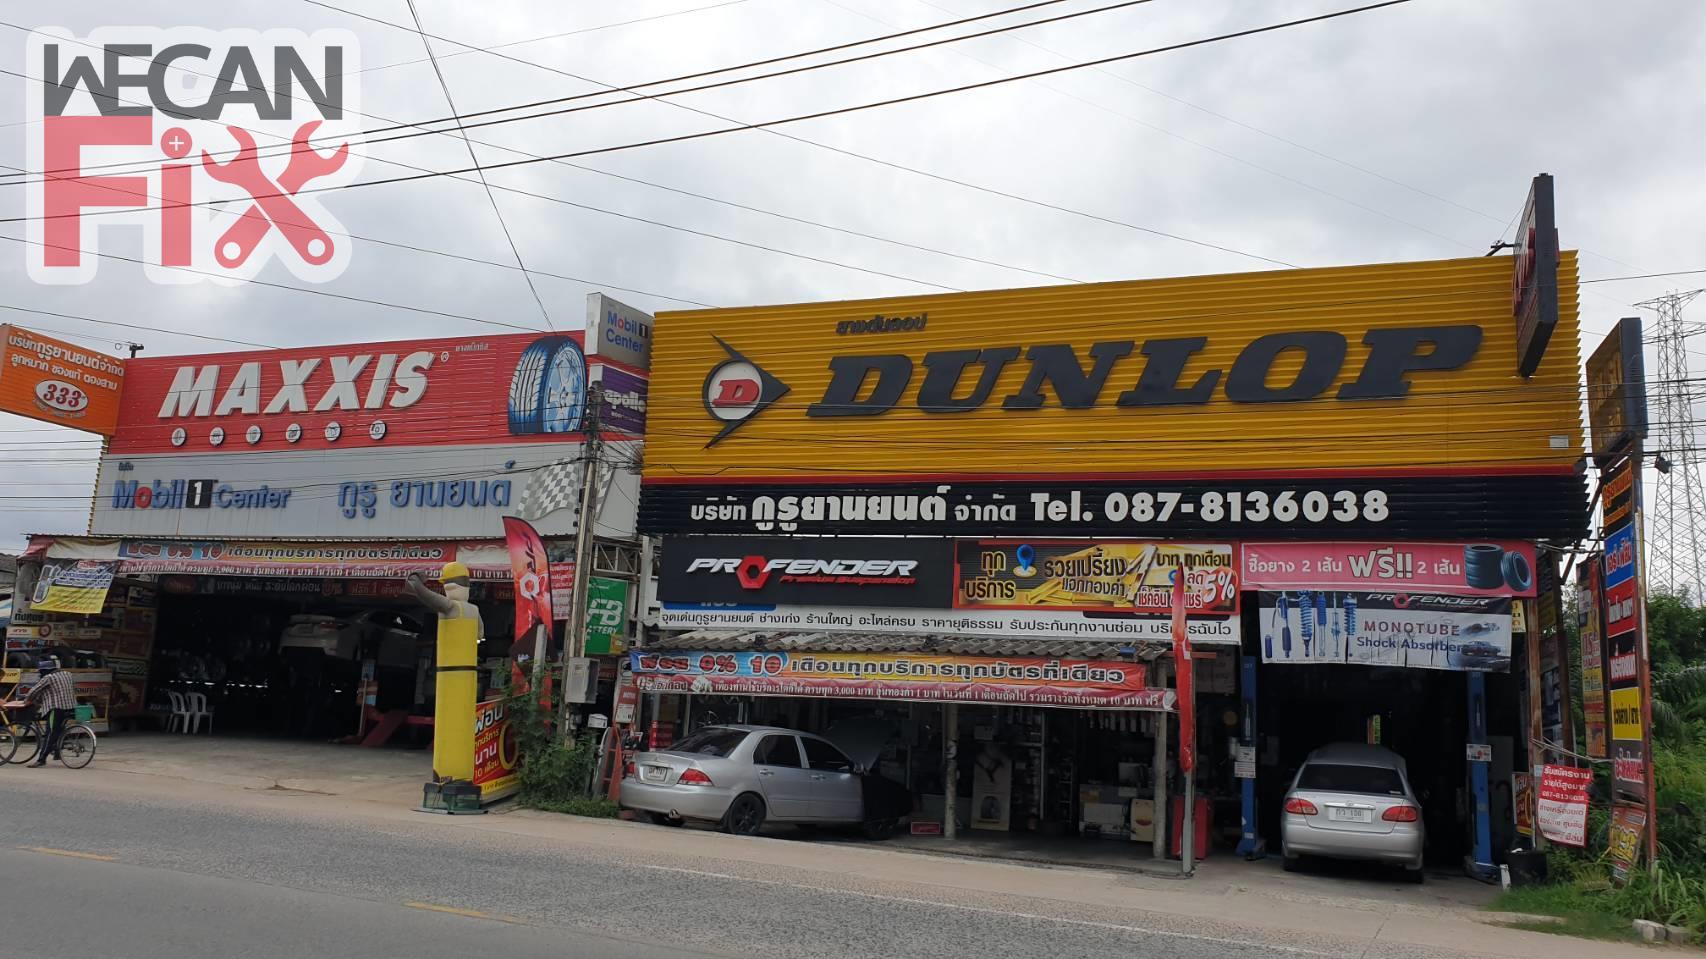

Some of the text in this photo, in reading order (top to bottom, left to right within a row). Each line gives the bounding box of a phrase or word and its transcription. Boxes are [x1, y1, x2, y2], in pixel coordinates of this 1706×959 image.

[607, 311, 648, 338] Mobil 1
[606, 328, 643, 353] Center
[805, 325, 1483, 416] DUNLOP
[43, 383, 81, 408] 333
[158, 351, 435, 418] MAXXIS
[711, 379, 759, 407] D
[112, 479, 184, 509] Mobil
[214, 483, 291, 509] Center
[337, 481, 377, 519] กูรู
[691, 485, 1389, 531] บริษัท กูรูยานยนต์ จำกัด Tel. 087-8136038
[686, 555, 918, 589] PROFENDER
[983, 551, 1005, 577] ทุก
[1249, 547, 1460, 579] ซื้อยาง 2 เส้น ฟรี!! 2 เส้น
[965, 576, 1016, 600] บริการ
[1203, 571, 1236, 603] 5%
[1366, 594, 1490, 608] PROFENDER
[587, 625, 618, 636] ATTERY
[1364, 621, 1460, 636] MONOTUBE
[1357, 637, 1396, 649] Shock
[698, 653, 738, 673] 0%
[749, 653, 784, 676] 10
[834, 686, 855, 696] 3,000
